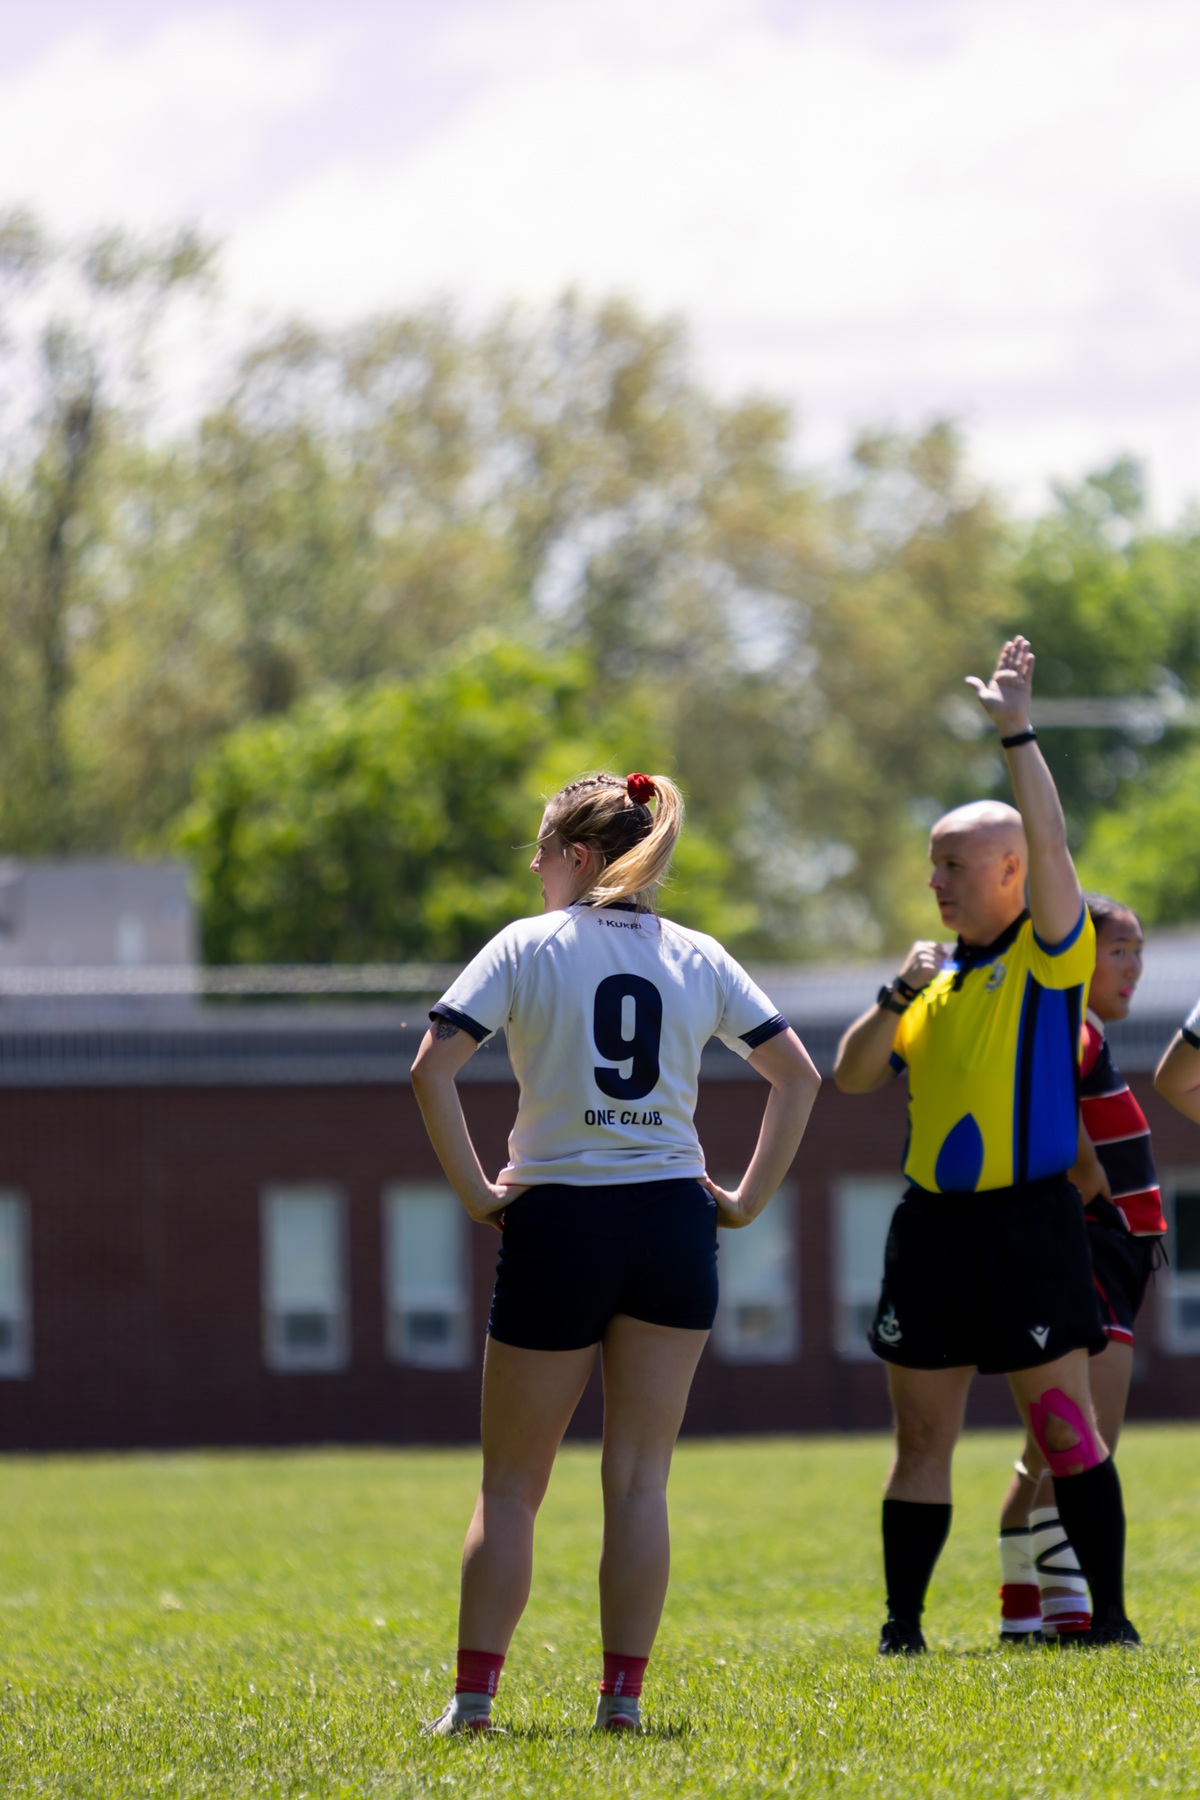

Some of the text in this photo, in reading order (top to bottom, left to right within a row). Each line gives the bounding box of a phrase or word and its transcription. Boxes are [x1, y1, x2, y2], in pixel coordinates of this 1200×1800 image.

[606, 919, 642, 930] KUKRI
[593, 973, 663, 1101] 9
[584, 1109, 663, 1126] ONE CLUB
